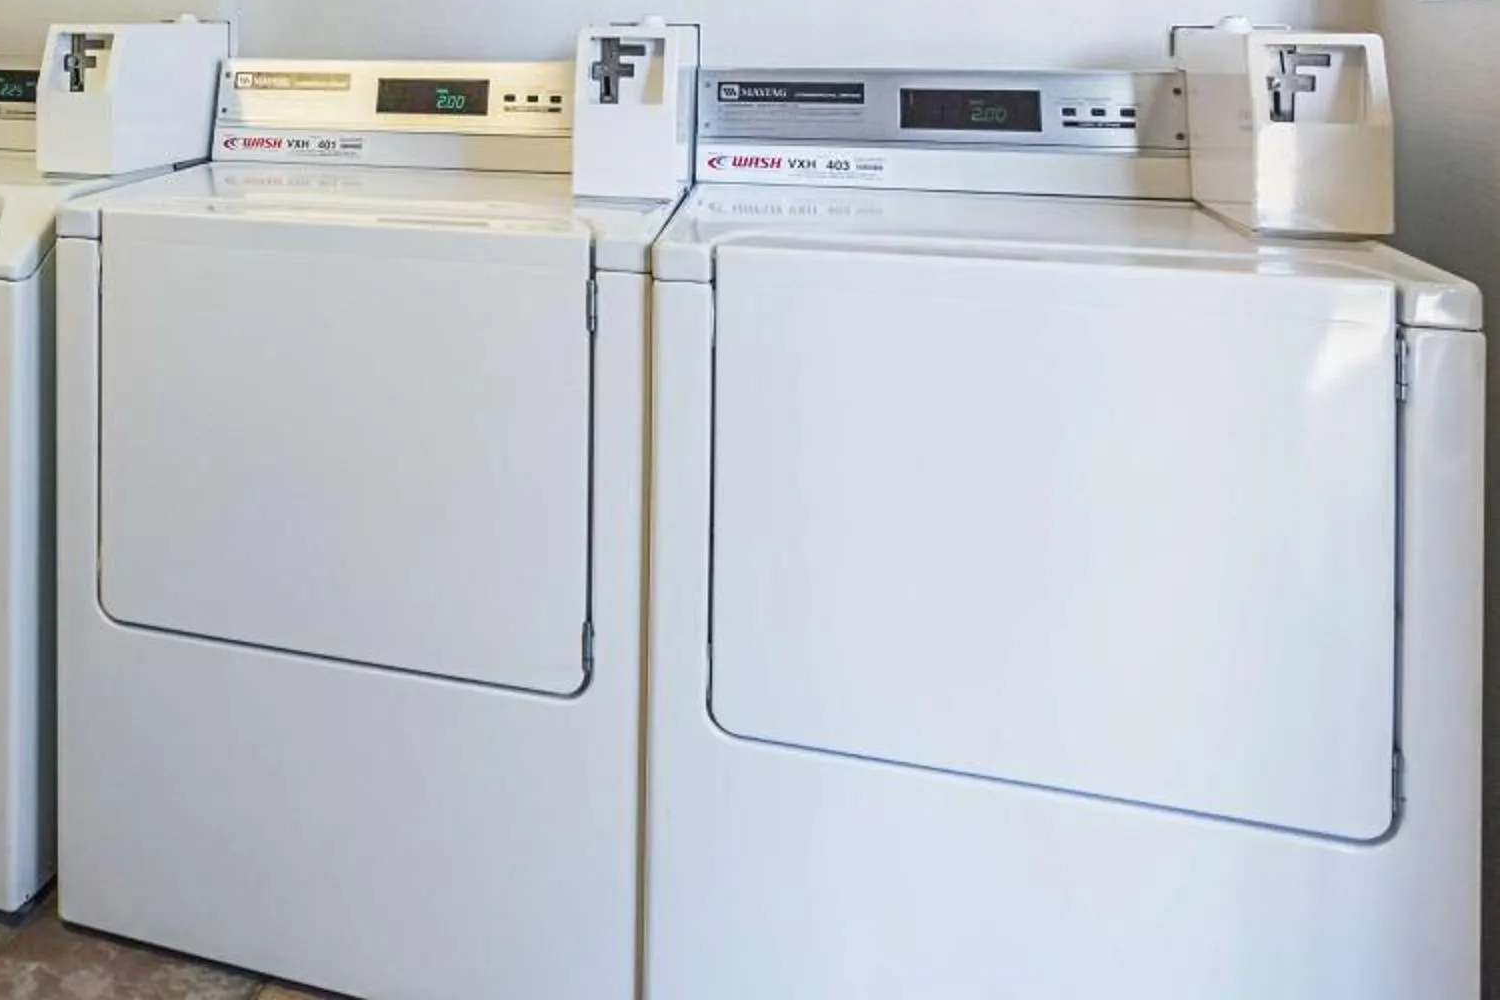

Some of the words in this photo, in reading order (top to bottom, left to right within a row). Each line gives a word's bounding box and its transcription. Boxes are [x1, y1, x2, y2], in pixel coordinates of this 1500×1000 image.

[739, 87, 787, 98] MAYTAG
[242, 136, 283, 149] WASH
[287, 139, 310, 150] VXH
[731, 155, 783, 169] WASH
[787, 158, 817, 169] VXH
[826, 160, 851, 171] 403
